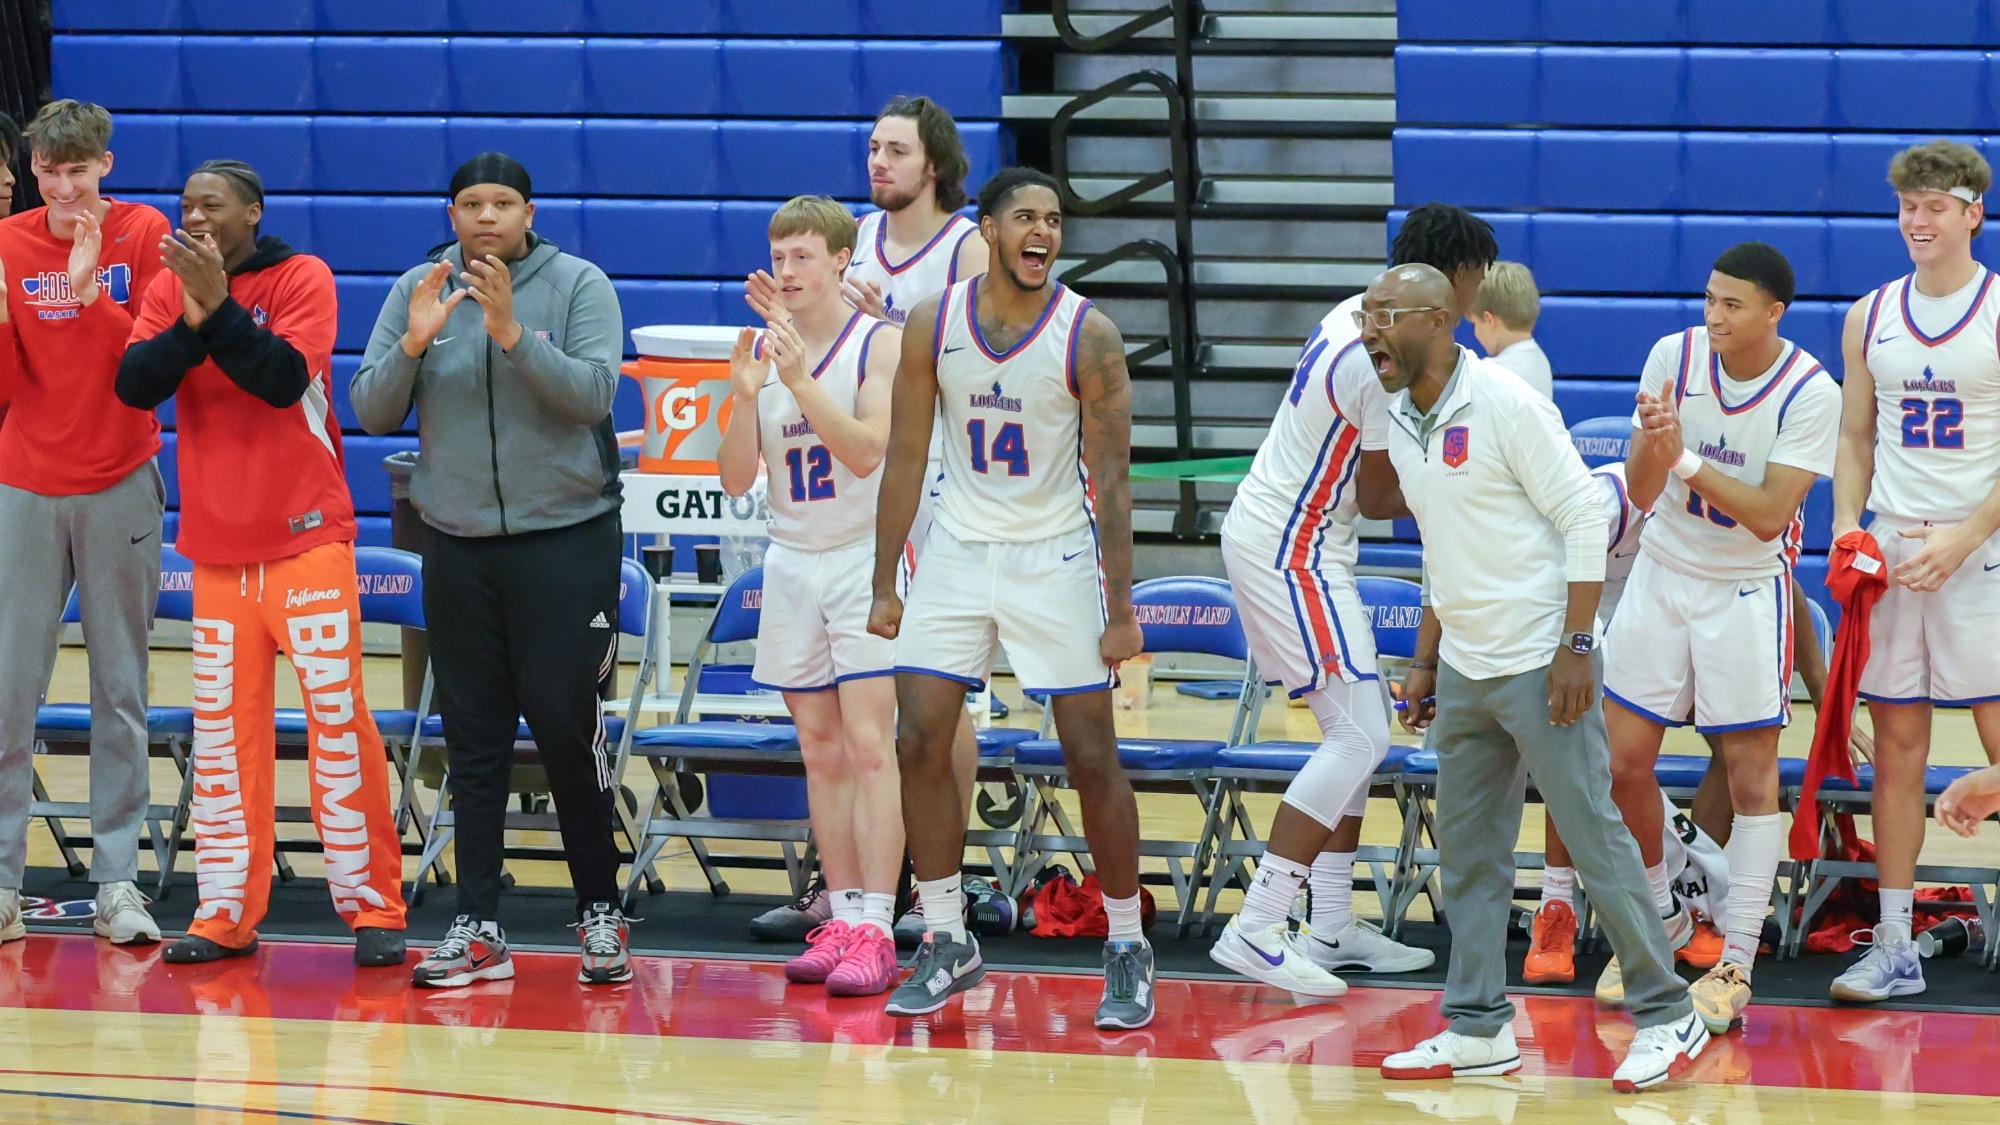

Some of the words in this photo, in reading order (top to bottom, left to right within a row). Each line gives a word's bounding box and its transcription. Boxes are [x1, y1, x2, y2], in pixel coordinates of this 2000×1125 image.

[38, 266, 106, 302] LOGS
[662, 386, 697, 430] G
[969, 394, 1022, 412] LOGGERS
[1900, 398, 1964, 449] 22
[967, 418, 1030, 476] 14
[785, 444, 836, 502] 12
[160, 571, 194, 591] LAN
[285, 588, 341, 609] Influence
[372, 574, 413, 594] LAND
[1192, 606, 1231, 625] LAND
[1376, 605, 1423, 628] LAND
[192, 617, 235, 712] GOOD
[286, 609, 355, 725] BAD
[192, 715, 250, 925] INTENTIONS
[315, 732, 387, 914] TIMING
